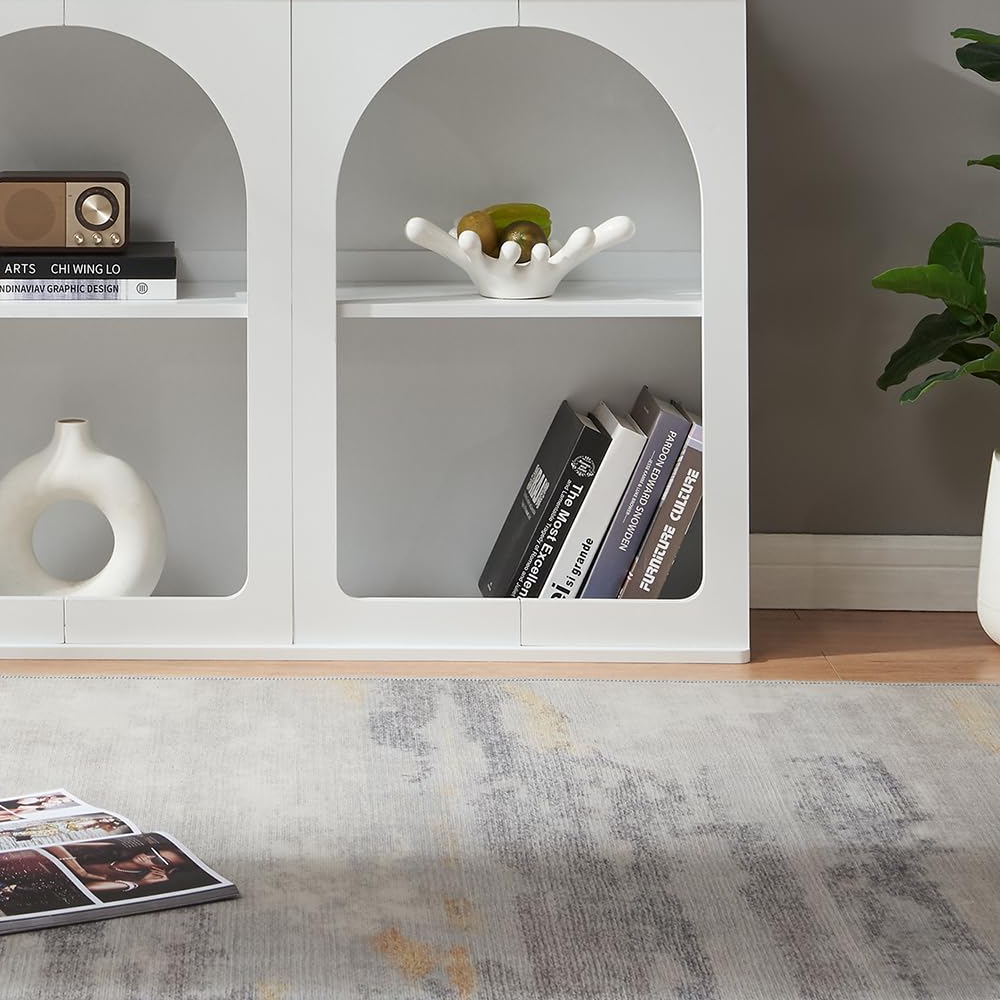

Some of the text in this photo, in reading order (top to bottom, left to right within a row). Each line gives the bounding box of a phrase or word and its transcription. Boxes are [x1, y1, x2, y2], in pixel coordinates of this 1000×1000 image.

[4, 263, 121, 275] ARTS CHI WING LO
[47, 284, 85, 294] GRAPHIC
[87, 284, 120, 294] DESIGN
[564, 484, 584, 507] The
[618, 430, 678, 552] PARDON EDWARD SNOWDEN
[546, 508, 571, 542] Most
[565, 575, 576, 588] si
[571, 537, 594, 577] grande
